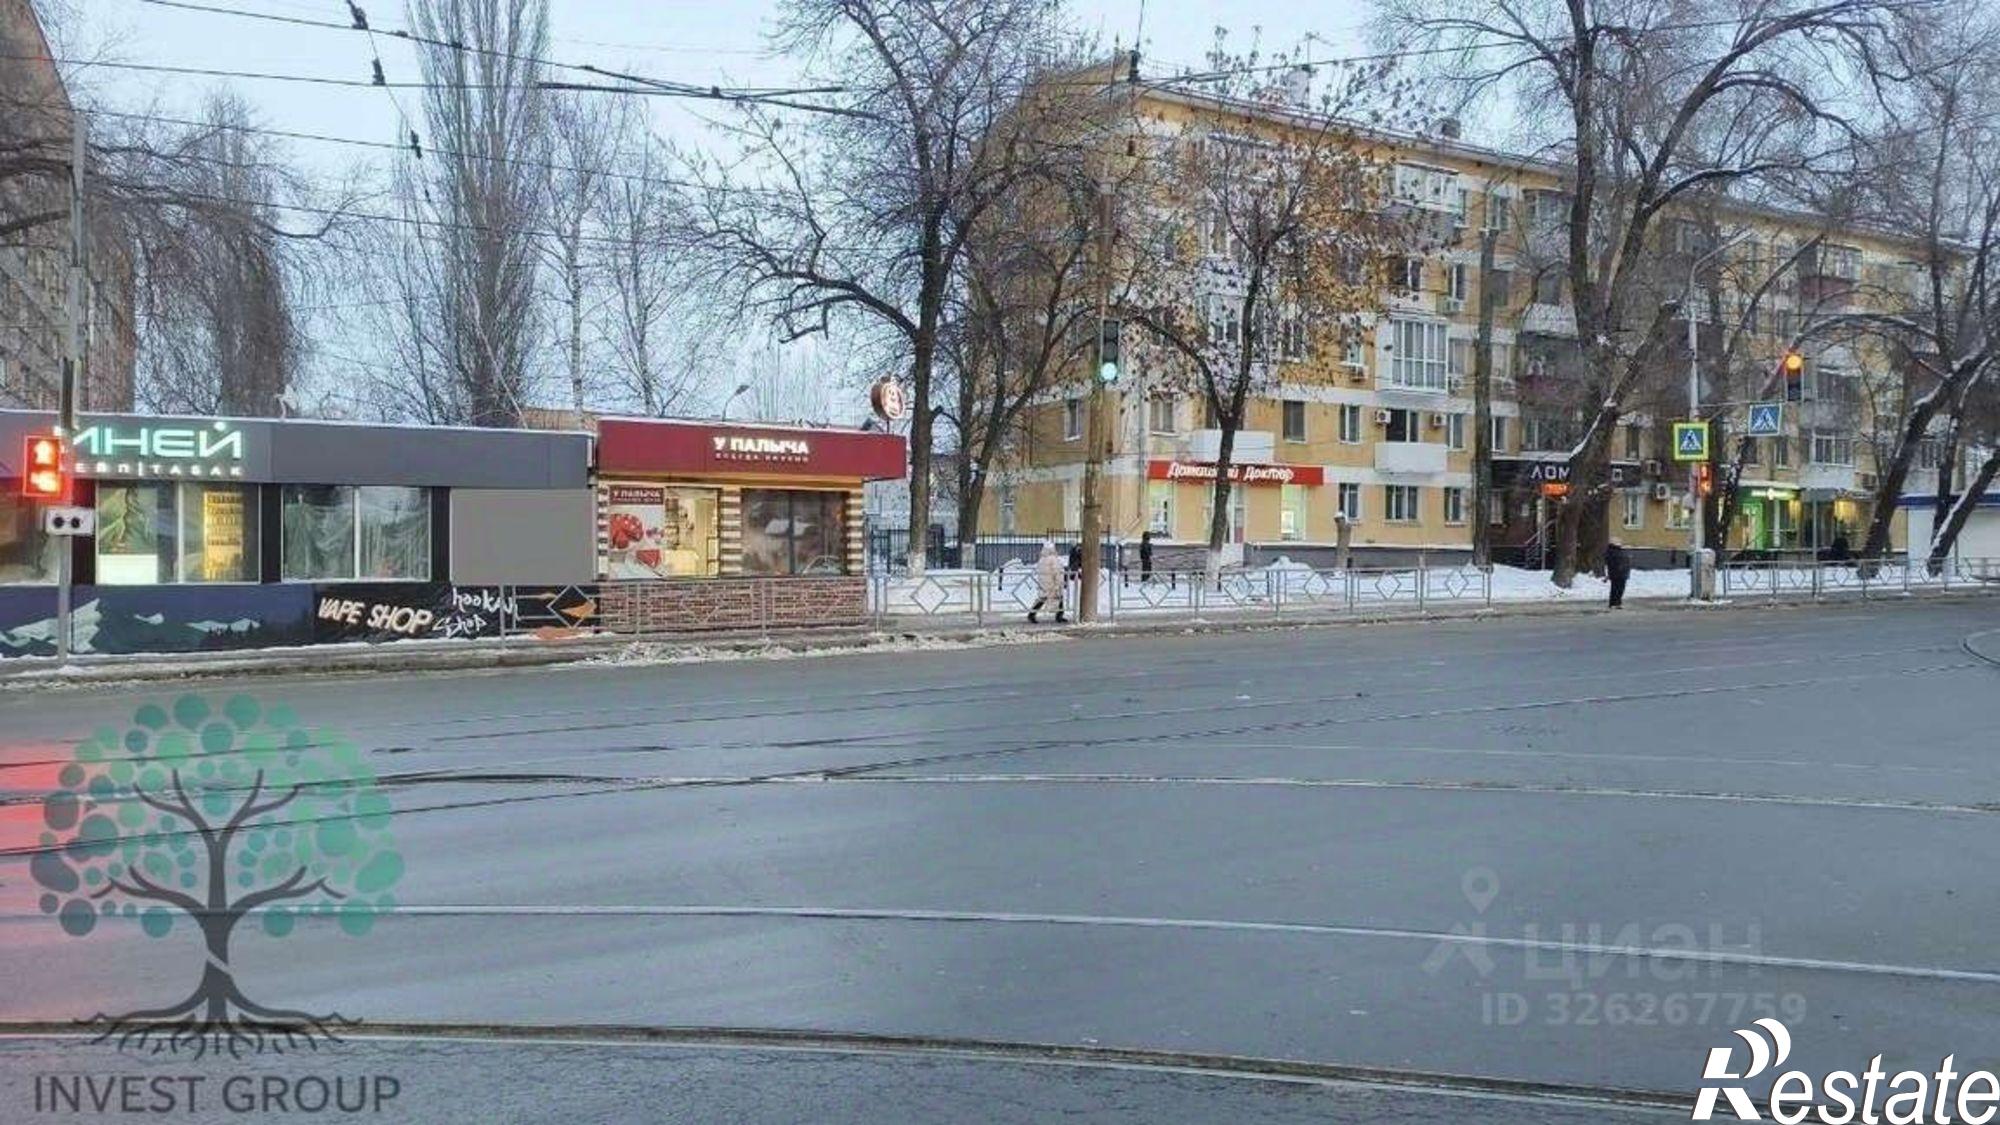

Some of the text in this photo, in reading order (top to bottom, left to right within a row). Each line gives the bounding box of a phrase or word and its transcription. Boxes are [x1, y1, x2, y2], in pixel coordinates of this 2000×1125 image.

[713, 437, 809, 454] У ПАЛЫЧА
[318, 597, 433, 634] VAPE SHOP
